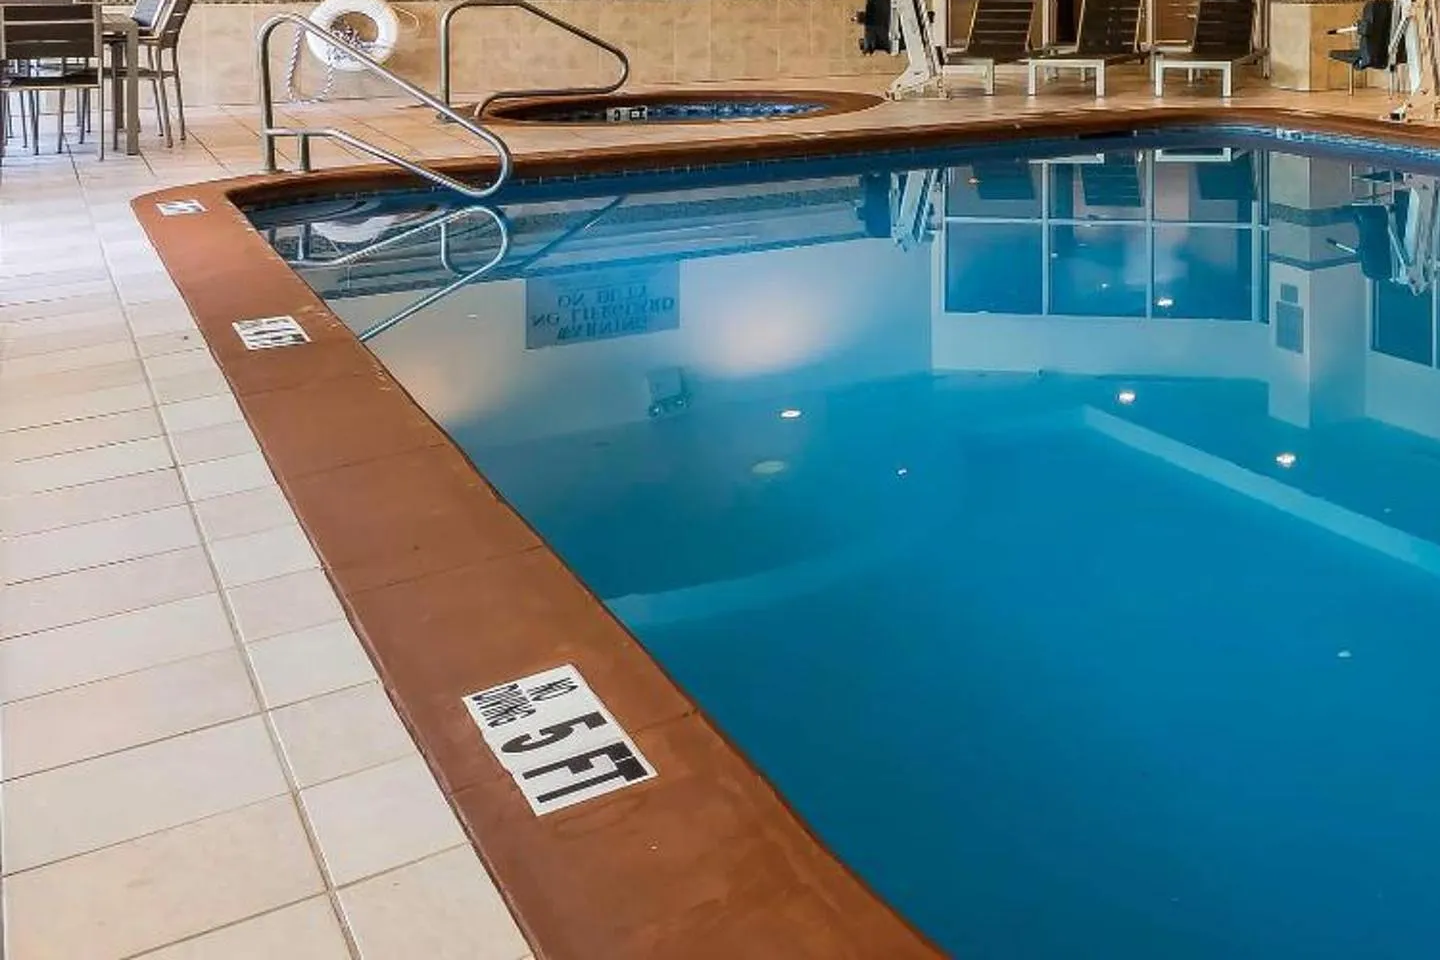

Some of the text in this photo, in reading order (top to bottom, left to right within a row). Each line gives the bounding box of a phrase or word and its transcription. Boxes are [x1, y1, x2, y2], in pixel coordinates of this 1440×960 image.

[526, 677, 579, 702] NO
[501, 711, 649, 803] 5 FT
